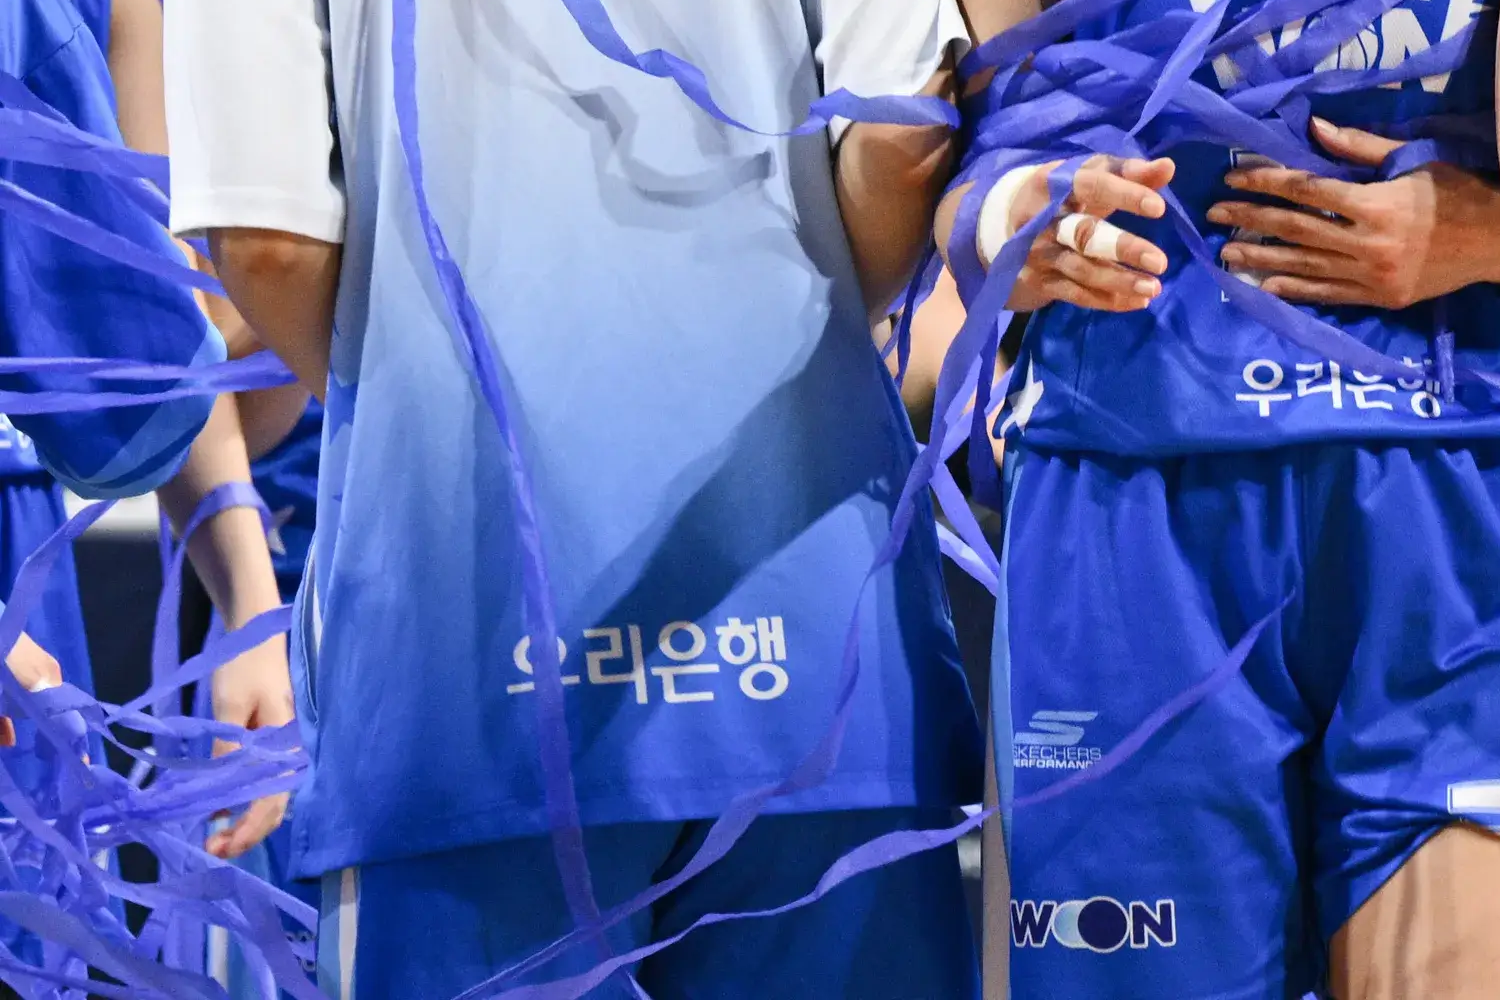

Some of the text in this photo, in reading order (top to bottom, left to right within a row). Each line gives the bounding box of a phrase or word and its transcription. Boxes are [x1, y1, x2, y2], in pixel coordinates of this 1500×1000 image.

[1235, 356, 1441, 419] 우리은행
[1012, 758, 1095, 770] ERFORMAN
[1010, 896, 1177, 953] WON
